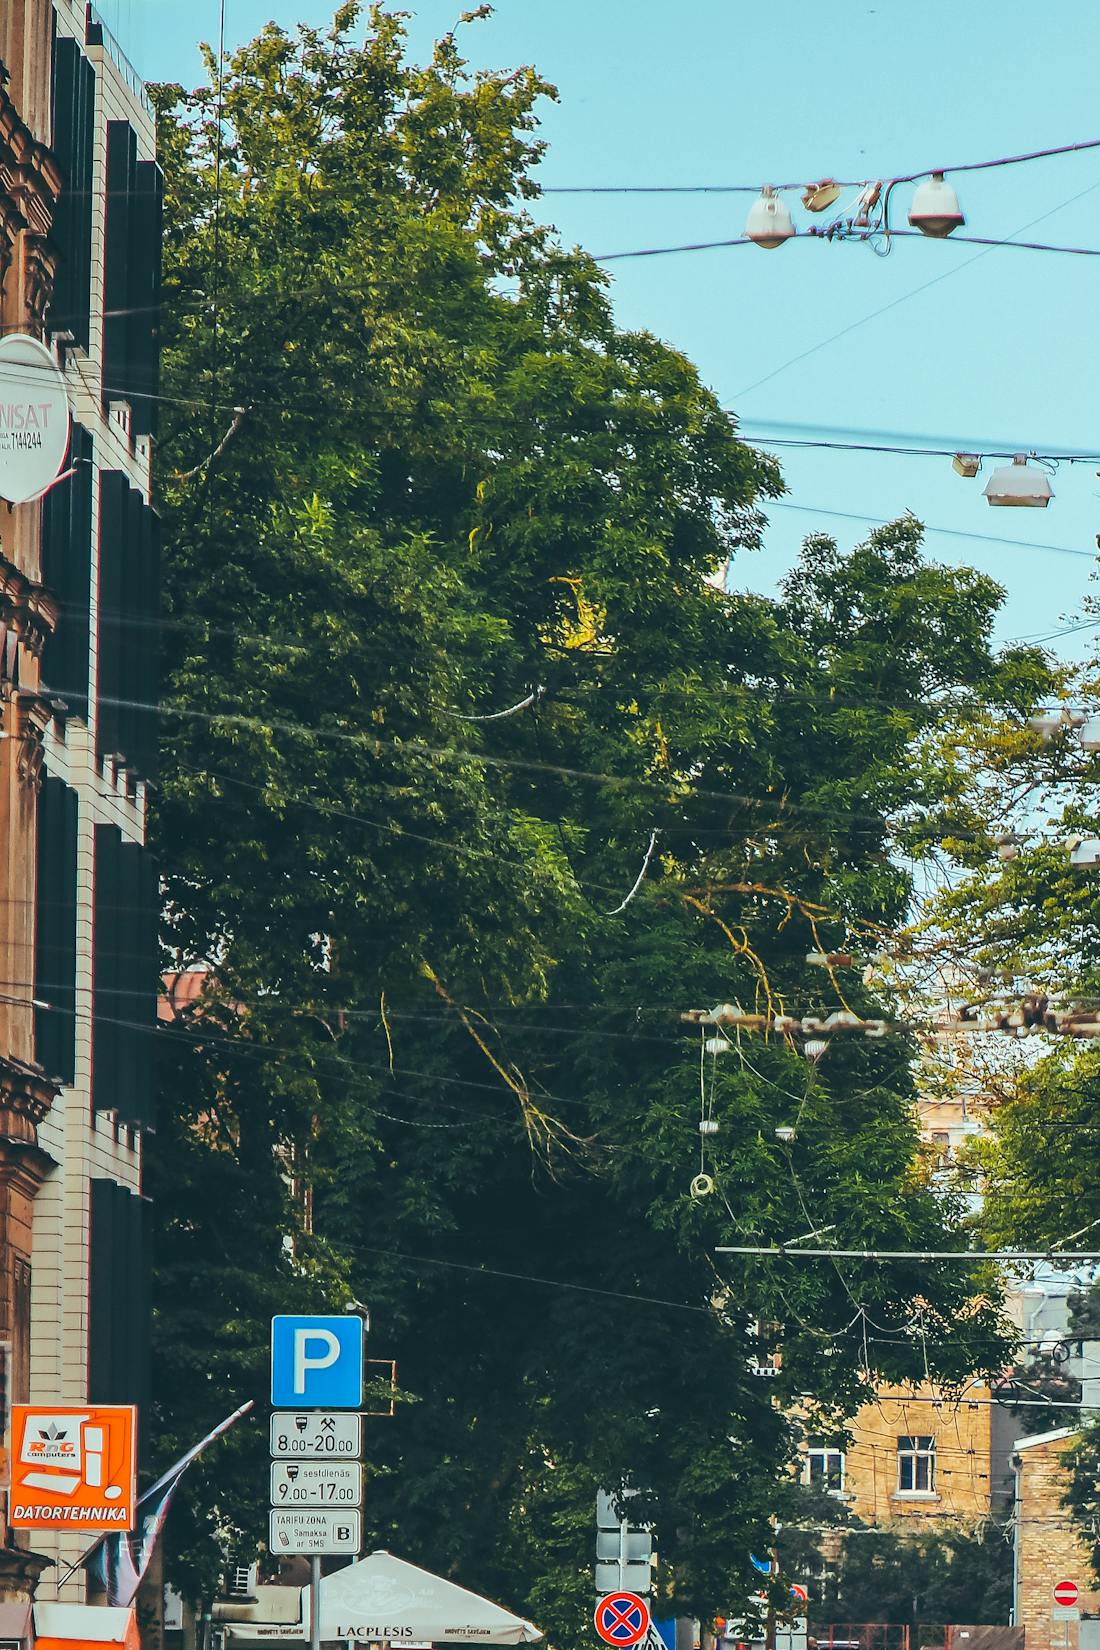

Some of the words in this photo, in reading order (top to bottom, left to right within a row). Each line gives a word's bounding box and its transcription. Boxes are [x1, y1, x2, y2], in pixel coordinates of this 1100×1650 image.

[293, 1328, 340, 1394] P
[13, 1505, 127, 1521] DATORTEHNIKA
[306, 1516, 327, 1525] ZONA
[293, 1528, 327, 1537] Samaksa
[337, 1527, 350, 1540] B
[308, 1540, 325, 1548] SMS
